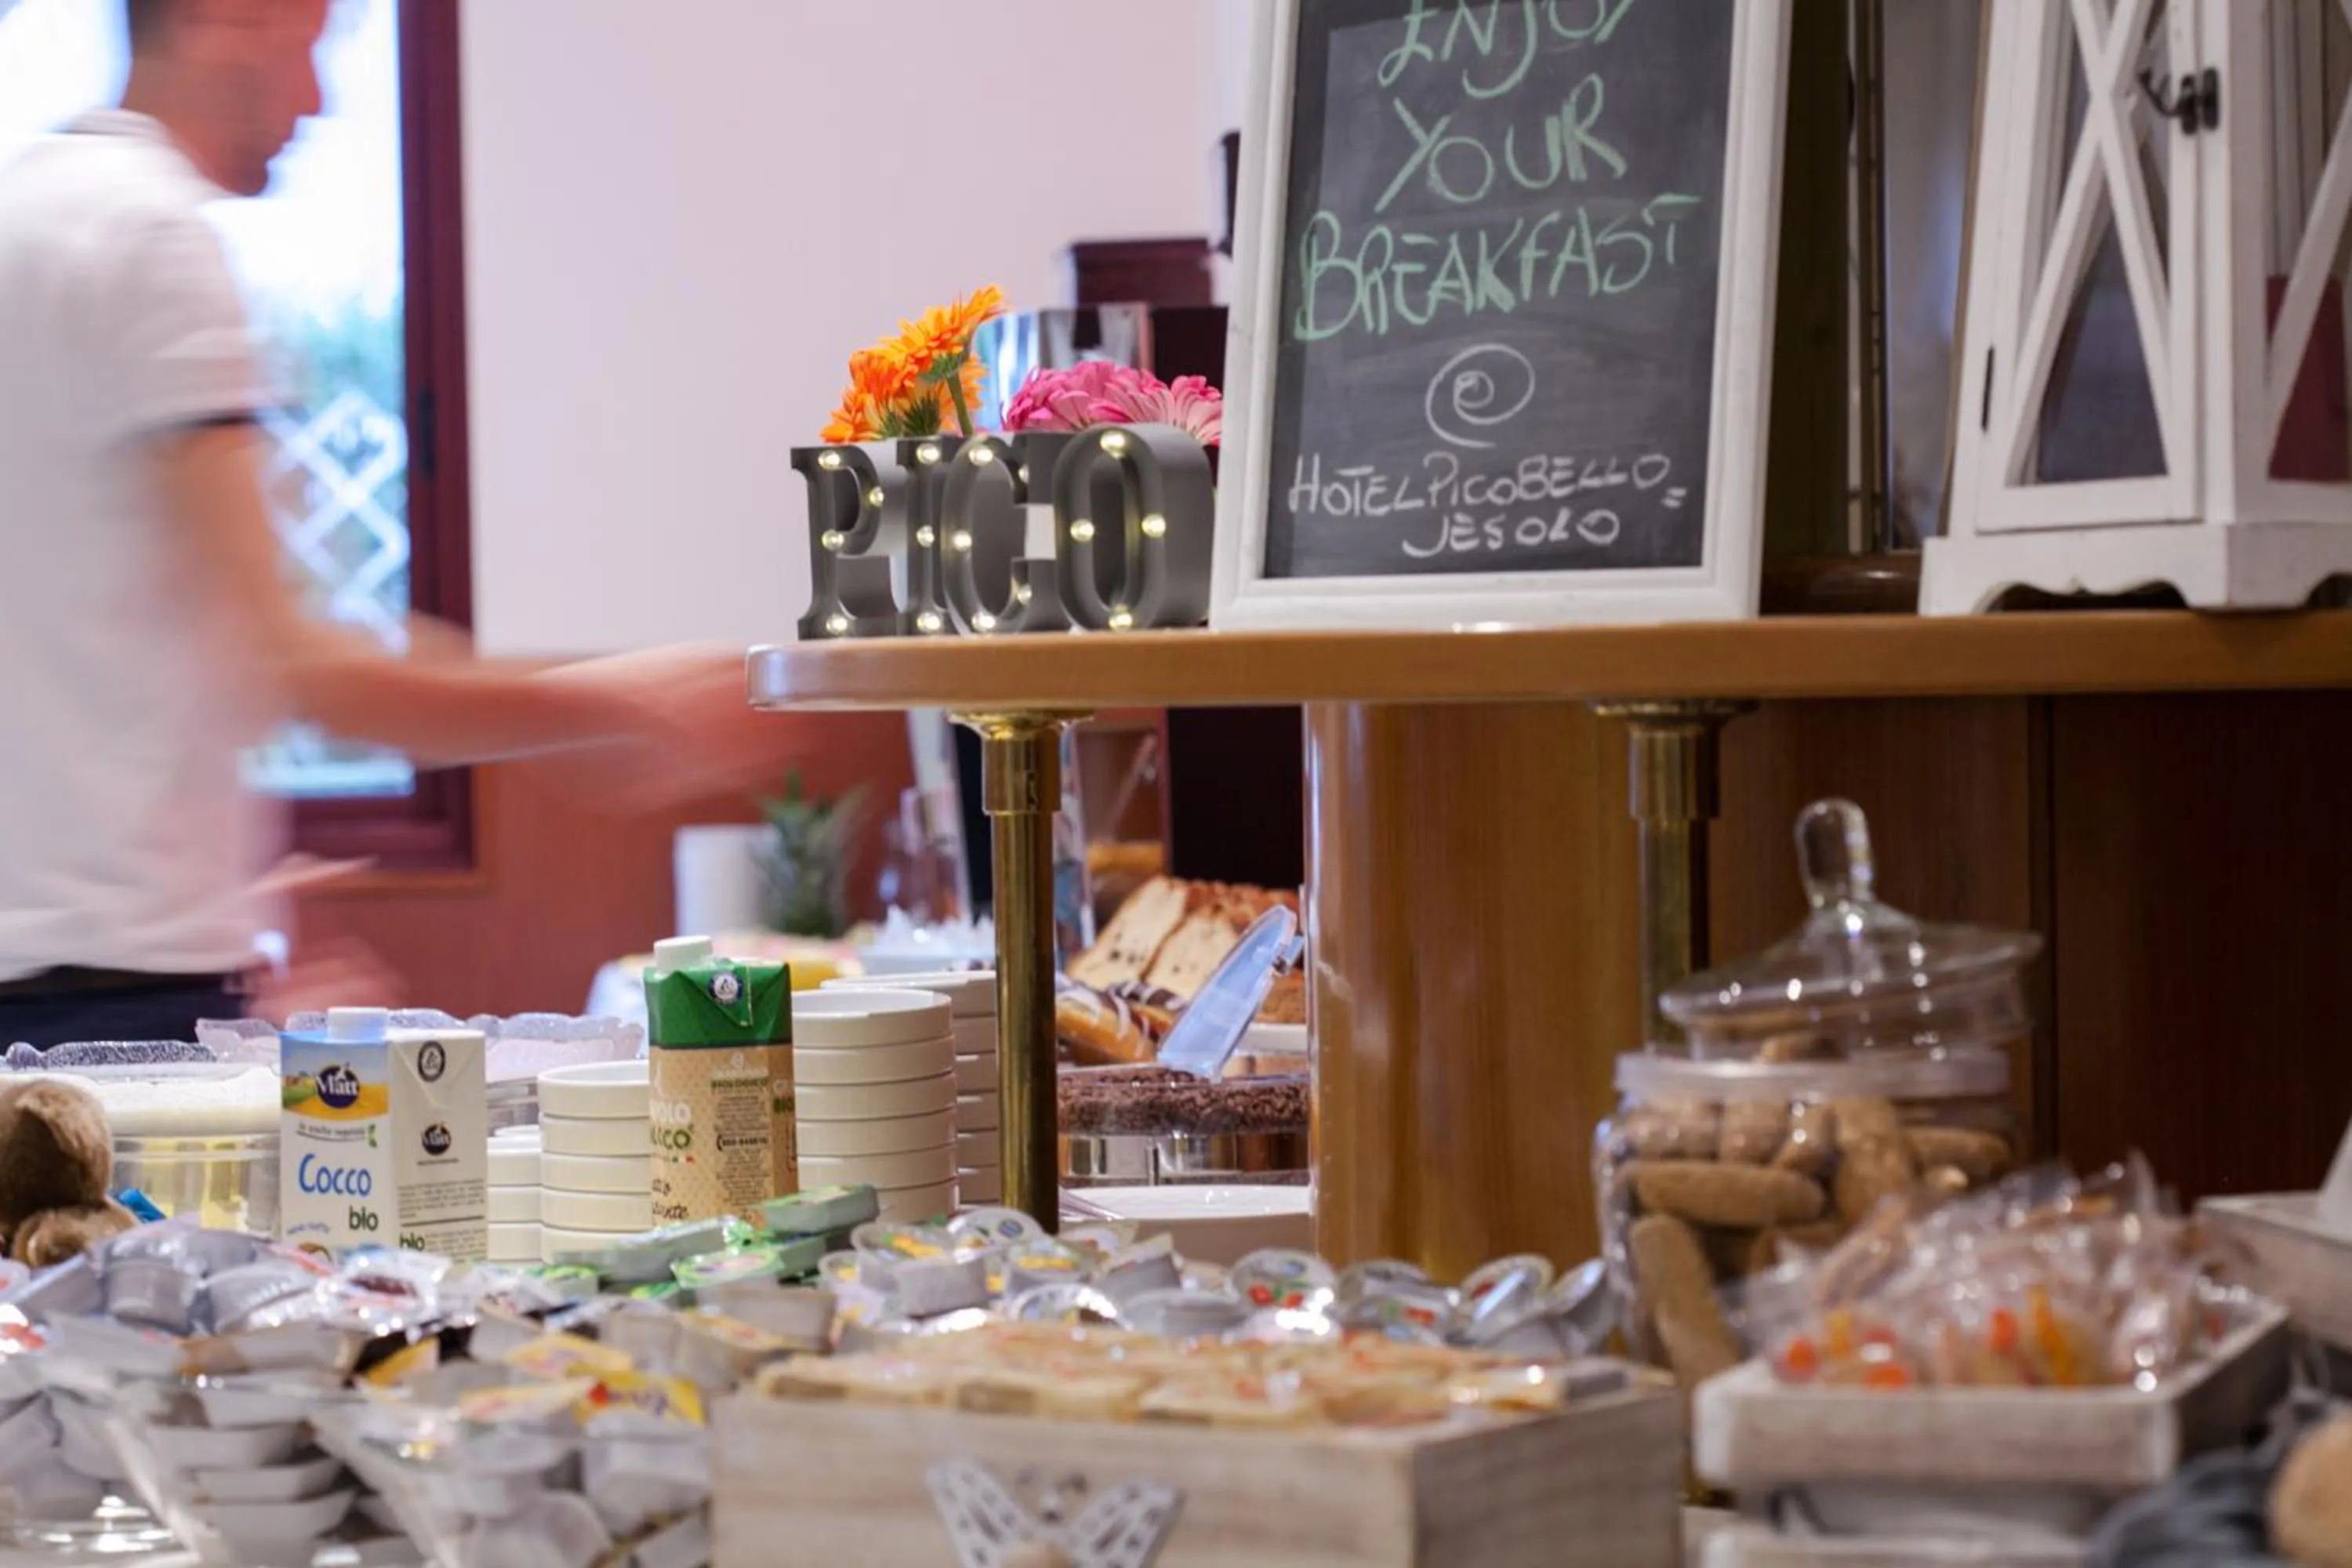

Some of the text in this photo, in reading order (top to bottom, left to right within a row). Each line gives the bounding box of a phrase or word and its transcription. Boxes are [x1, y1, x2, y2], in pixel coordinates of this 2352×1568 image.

[1375, 73, 1628, 213] YOUR
[1293, 192, 1701, 341] BREAKFAST
[1288, 452, 1425, 517] HOTEL
[790, 423, 1215, 641] PICO
[1401, 506, 1621, 557] JESOLO
[298, 1153, 372, 1197] Cocco
[348, 1205, 379, 1232] bio
